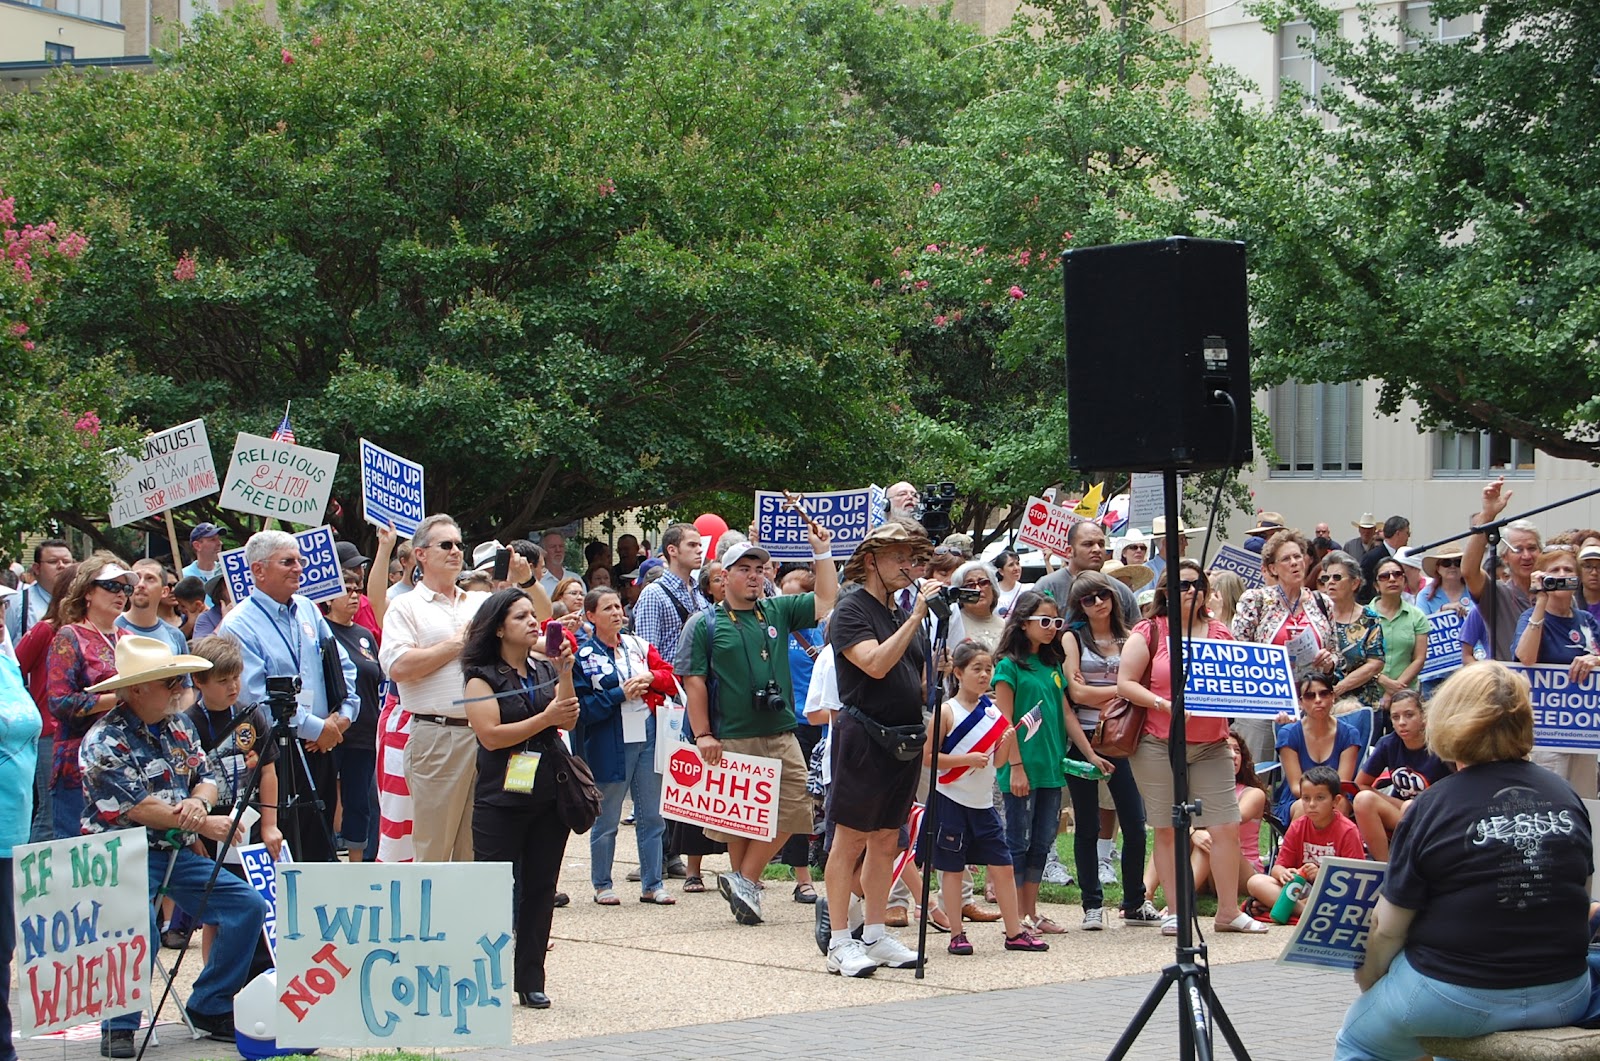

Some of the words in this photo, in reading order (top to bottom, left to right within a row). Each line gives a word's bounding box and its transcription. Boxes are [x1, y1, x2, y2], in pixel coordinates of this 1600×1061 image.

[141, 425, 197, 461] UNJUST
[138, 476, 156, 494] NO
[162, 463, 189, 485] LAW
[193, 456, 208, 473] AT
[145, 453, 177, 476] LAW
[237, 448, 326, 483] RELIGIOUS
[365, 446, 400, 479] STAND
[403, 466, 420, 486] UP
[231, 479, 318, 514] FREEDOM
[251, 464, 284, 493] Est
[283, 476, 309, 499] 1791
[371, 469, 420, 503] RELIGIOUS
[119, 500, 144, 521] ALL
[144, 489, 166, 511] STOP
[371, 486, 421, 520] FREEDOM
[762, 496, 834, 513] STND
[840, 494, 866, 512] UP
[1030, 508, 1047, 520] STOP
[1051, 508, 1082, 523] OBAMA'
[761, 514, 773, 541] FOR
[775, 511, 866, 528] RELGIOUS
[1046, 516, 1070, 537] HH
[299, 532, 327, 553] UP
[1022, 524, 1068, 549] MANDAT
[231, 572, 246, 601] FOR
[1429, 614, 1460, 631] AND
[1253, 648, 1283, 666] UP
[1426, 640, 1461, 658] FREE
[1191, 661, 1287, 681] RELIGIOUS
[1184, 696, 1284, 706] tandUpForReligiousFreedom.com
[1193, 678, 1290, 697] FREEDOM
[671, 759, 701, 777] STOP
[720, 758, 775, 779] BAMA'S
[705, 769, 772, 805] HHS
[665, 785, 770, 825] MANDATE
[1473, 810, 1575, 845] JESUS
[20, 846, 53, 907] IF
[245, 854, 267, 891] UP
[281, 869, 305, 940] I
[20, 900, 135, 966] NOW...
[1302, 902, 1339, 943] FOR
[26, 934, 147, 1029] WHEN?
[279, 943, 352, 1023] NOT
